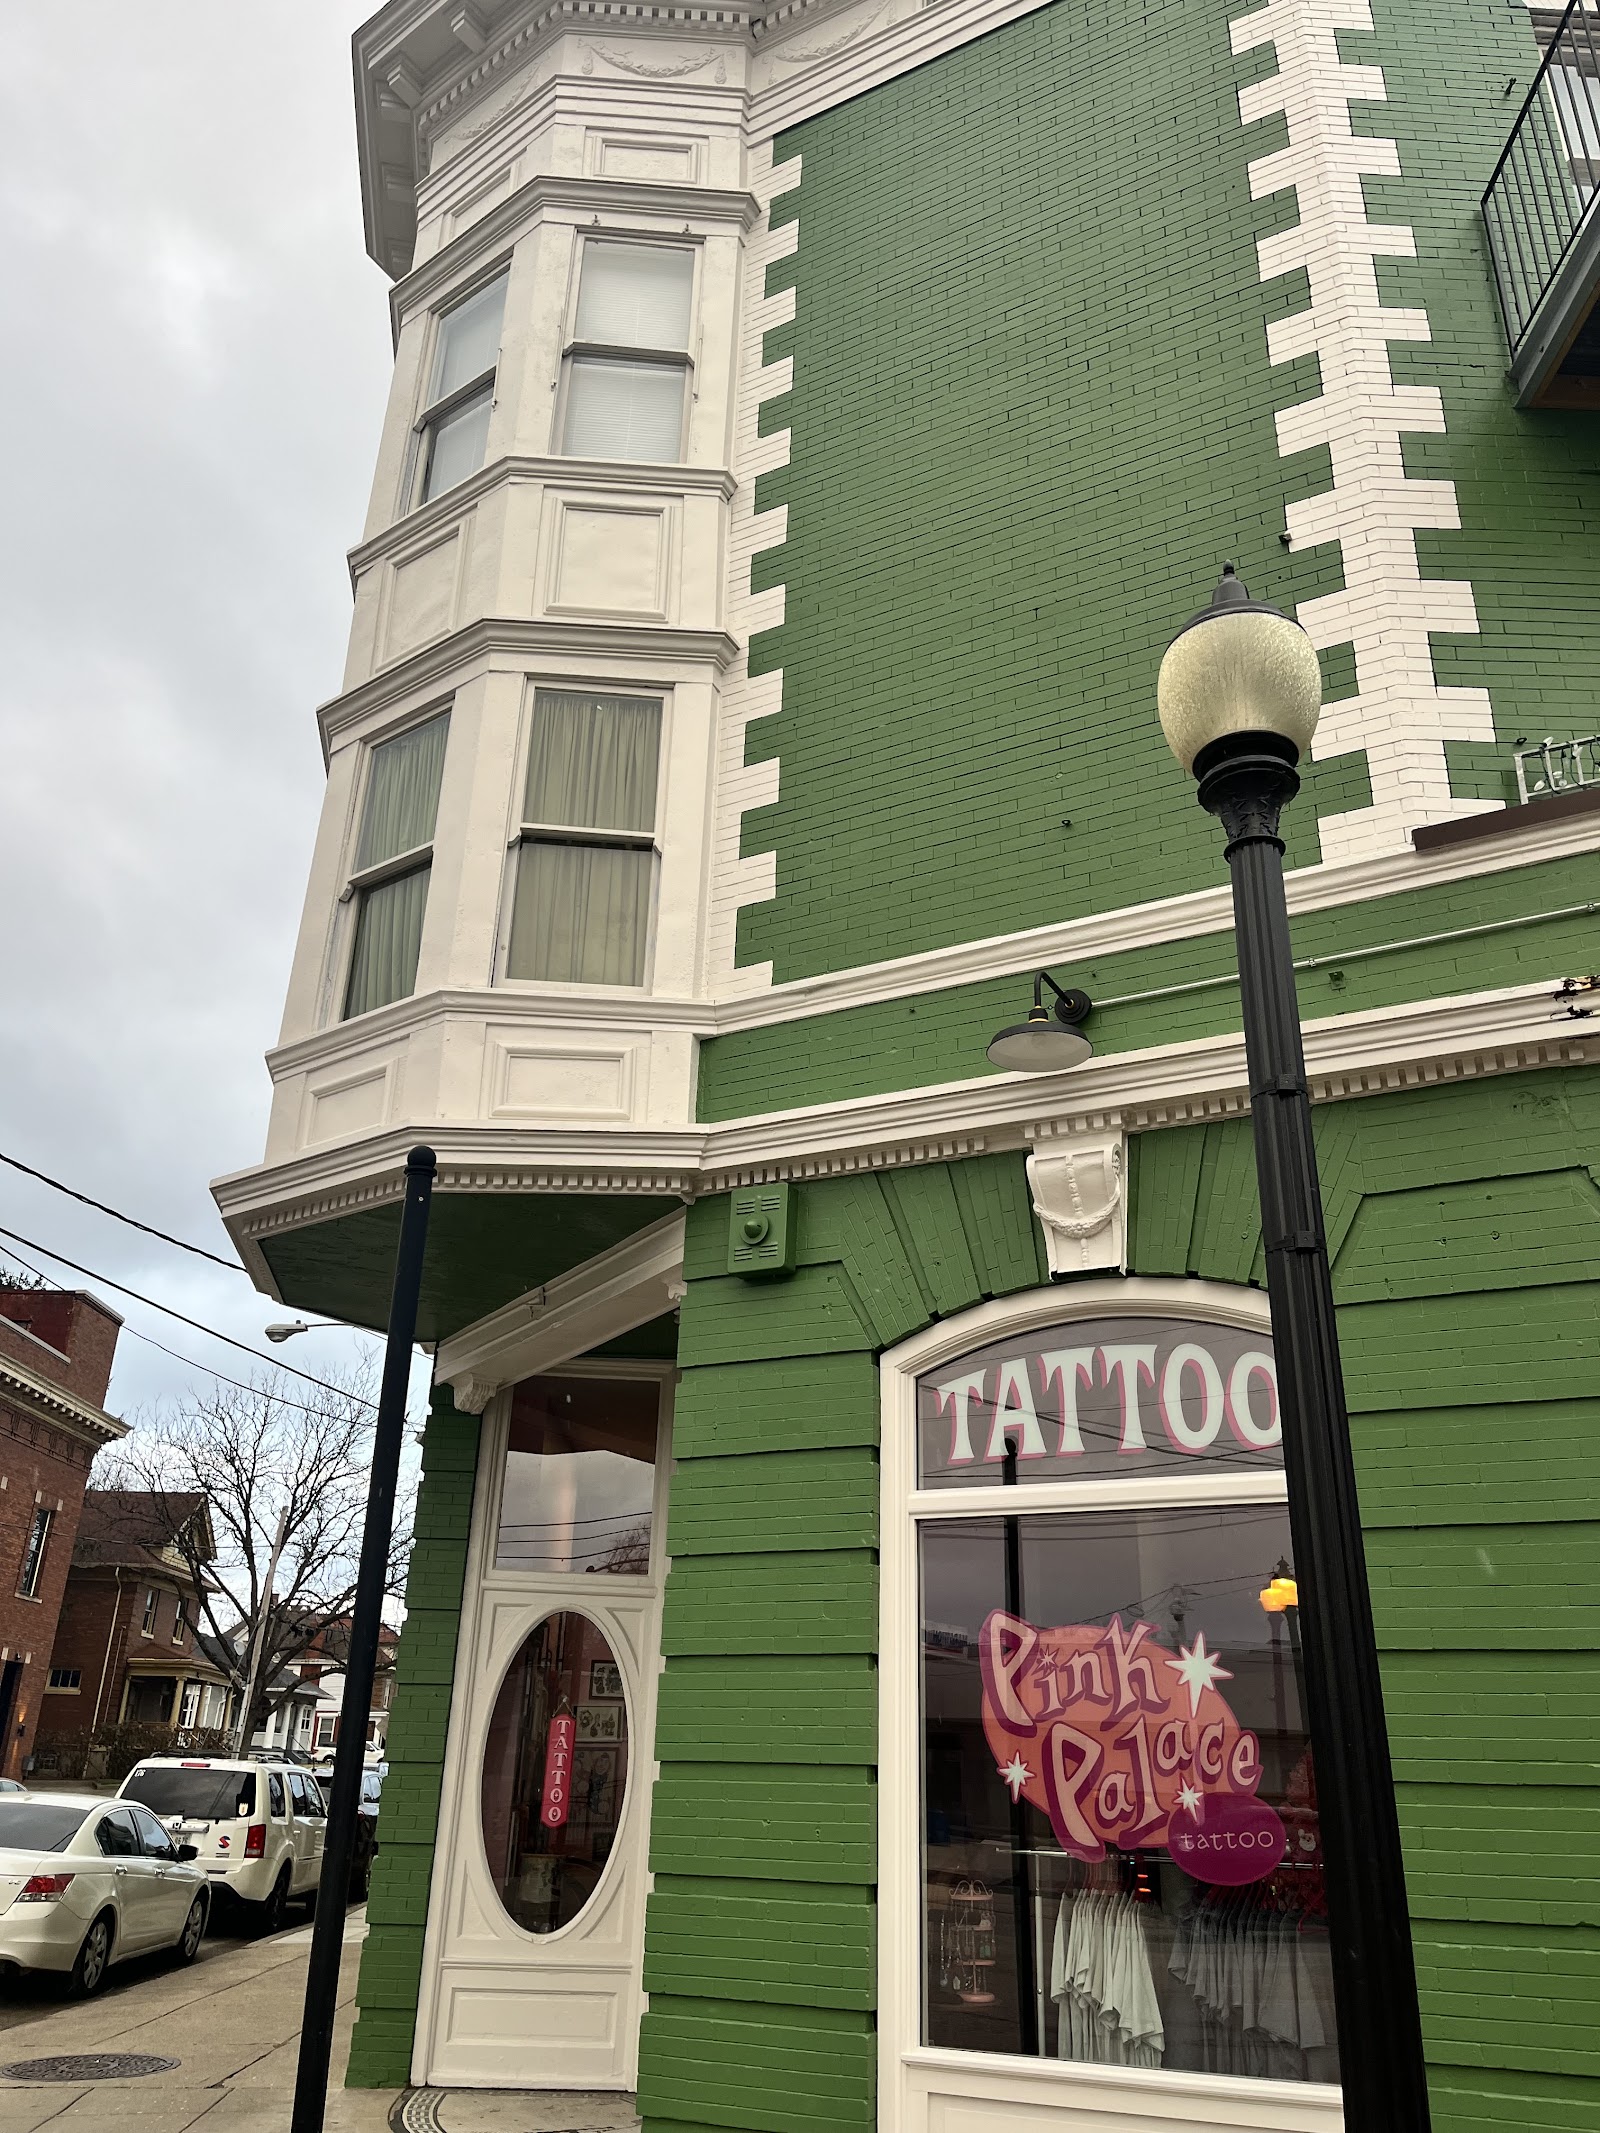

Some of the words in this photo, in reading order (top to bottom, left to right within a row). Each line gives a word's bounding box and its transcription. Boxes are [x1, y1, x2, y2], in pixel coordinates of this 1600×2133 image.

[935, 1343, 1283, 1465] TATTOO
[548, 1720, 571, 1822] TATTOO
[1047, 1715, 1259, 1851] Palace
[1182, 1831, 1275, 1851] tattoo
